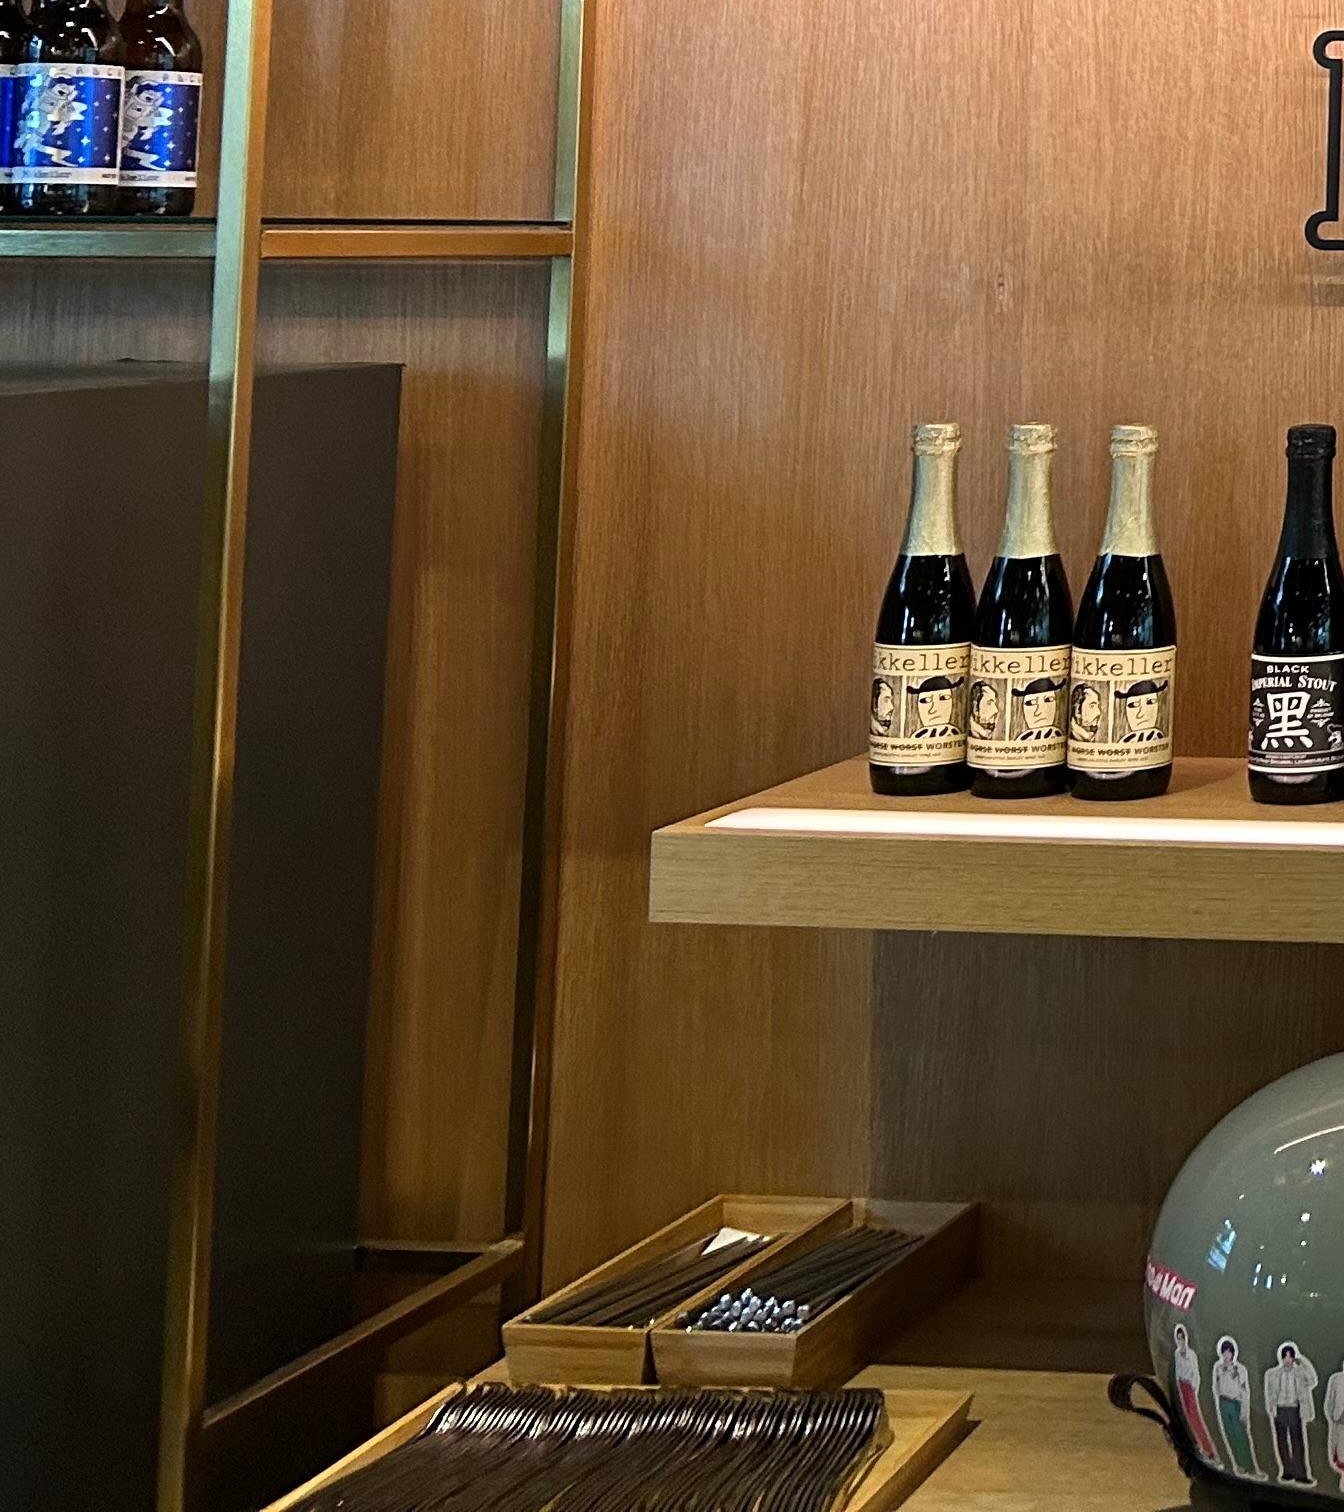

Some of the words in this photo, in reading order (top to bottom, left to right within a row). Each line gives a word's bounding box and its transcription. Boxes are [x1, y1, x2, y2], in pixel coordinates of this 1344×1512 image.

[1266, 664, 1310, 674] BLACK
[1297, 674, 1338, 692] STOUT
[1261, 691, 1313, 750] 黑
